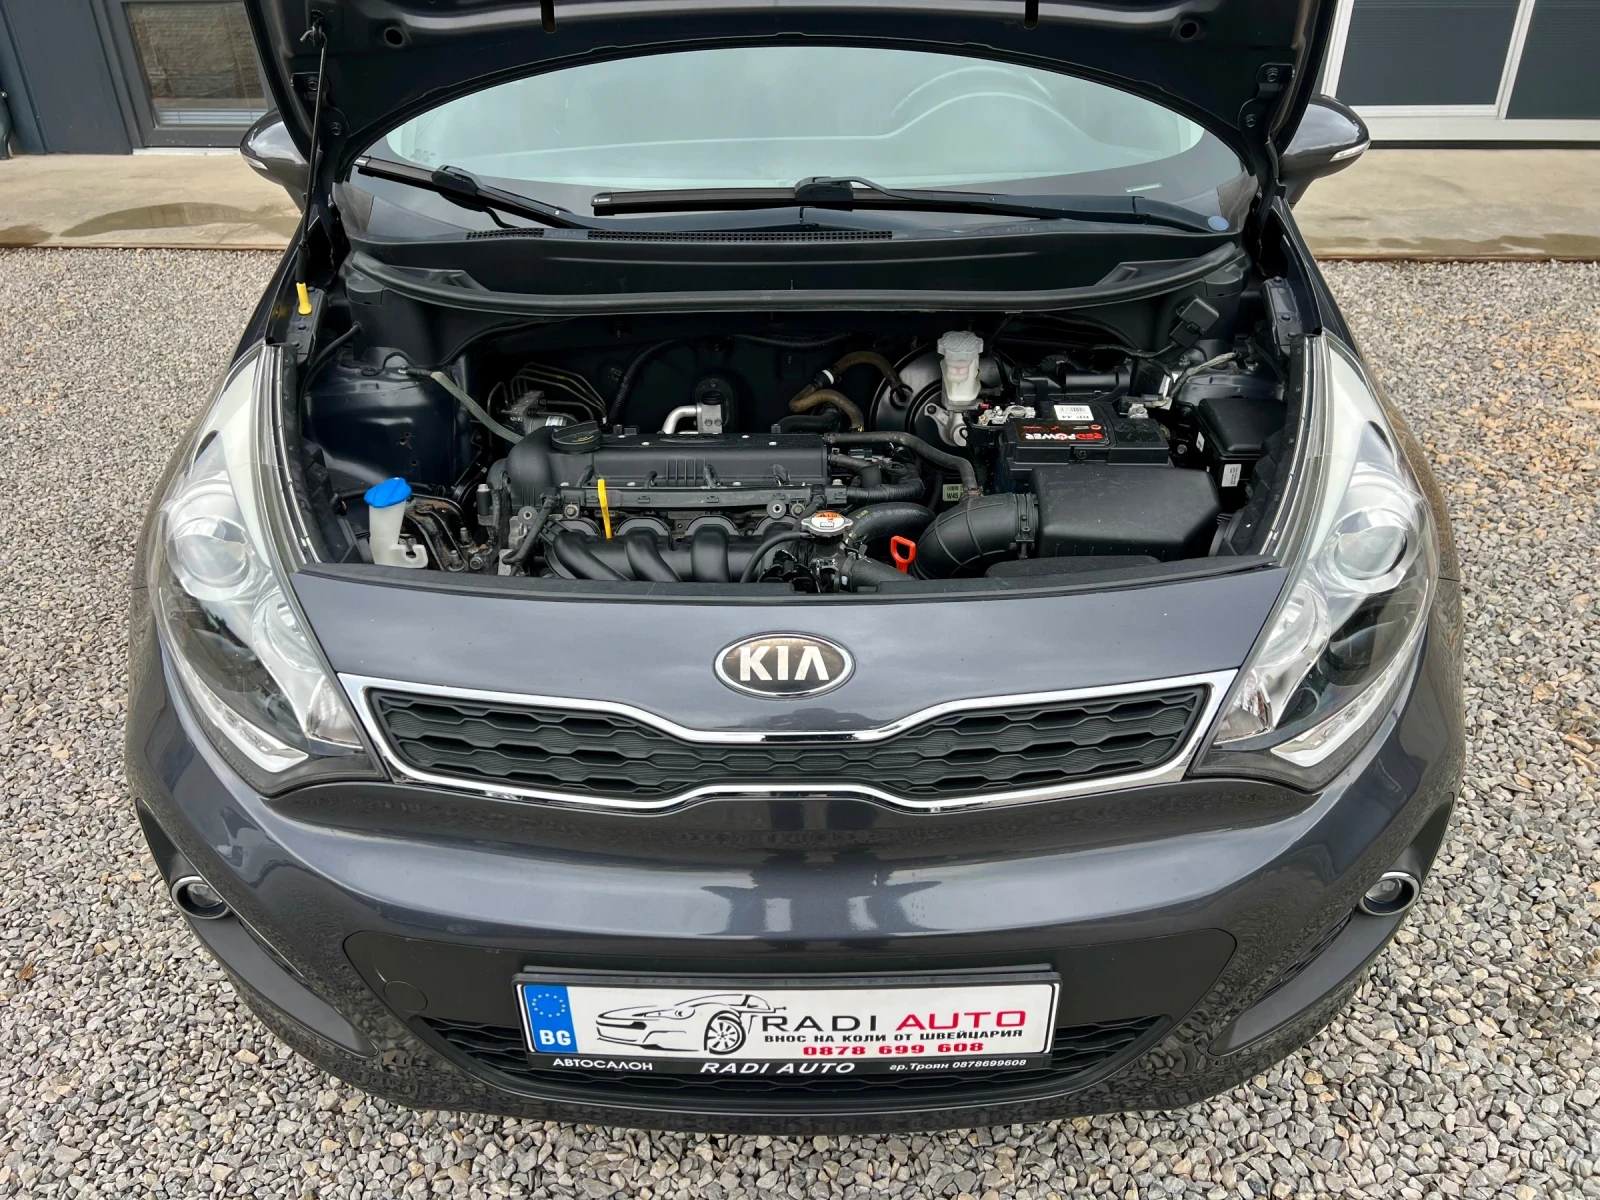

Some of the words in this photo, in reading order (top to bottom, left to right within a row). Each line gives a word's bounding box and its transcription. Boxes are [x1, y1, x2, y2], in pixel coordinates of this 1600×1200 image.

[739, 646, 830, 681] KIA
[762, 1015, 877, 1032] RADI
[895, 1011, 1026, 1031] AUTO
[539, 1029, 571, 1046] BG
[764, 1035, 807, 1043] ВНОС
[813, 1035, 835, 1043] НА
[842, 1034, 887, 1042] КОЛИ
[894, 1033, 914, 1041] ОТ
[920, 1029, 1023, 1041] ШВЕЙЦАРИЯ
[803, 1046, 866, 1056] 0878
[878, 1044, 925, 1055] 699
[937, 1042, 984, 1053] 608
[553, 1057, 653, 1071] АВТОСАЛОН
[700, 1062, 770, 1074] RADI
[776, 1062, 855, 1074] AUTO
[952, 1059, 1027, 1068] 0878699608
